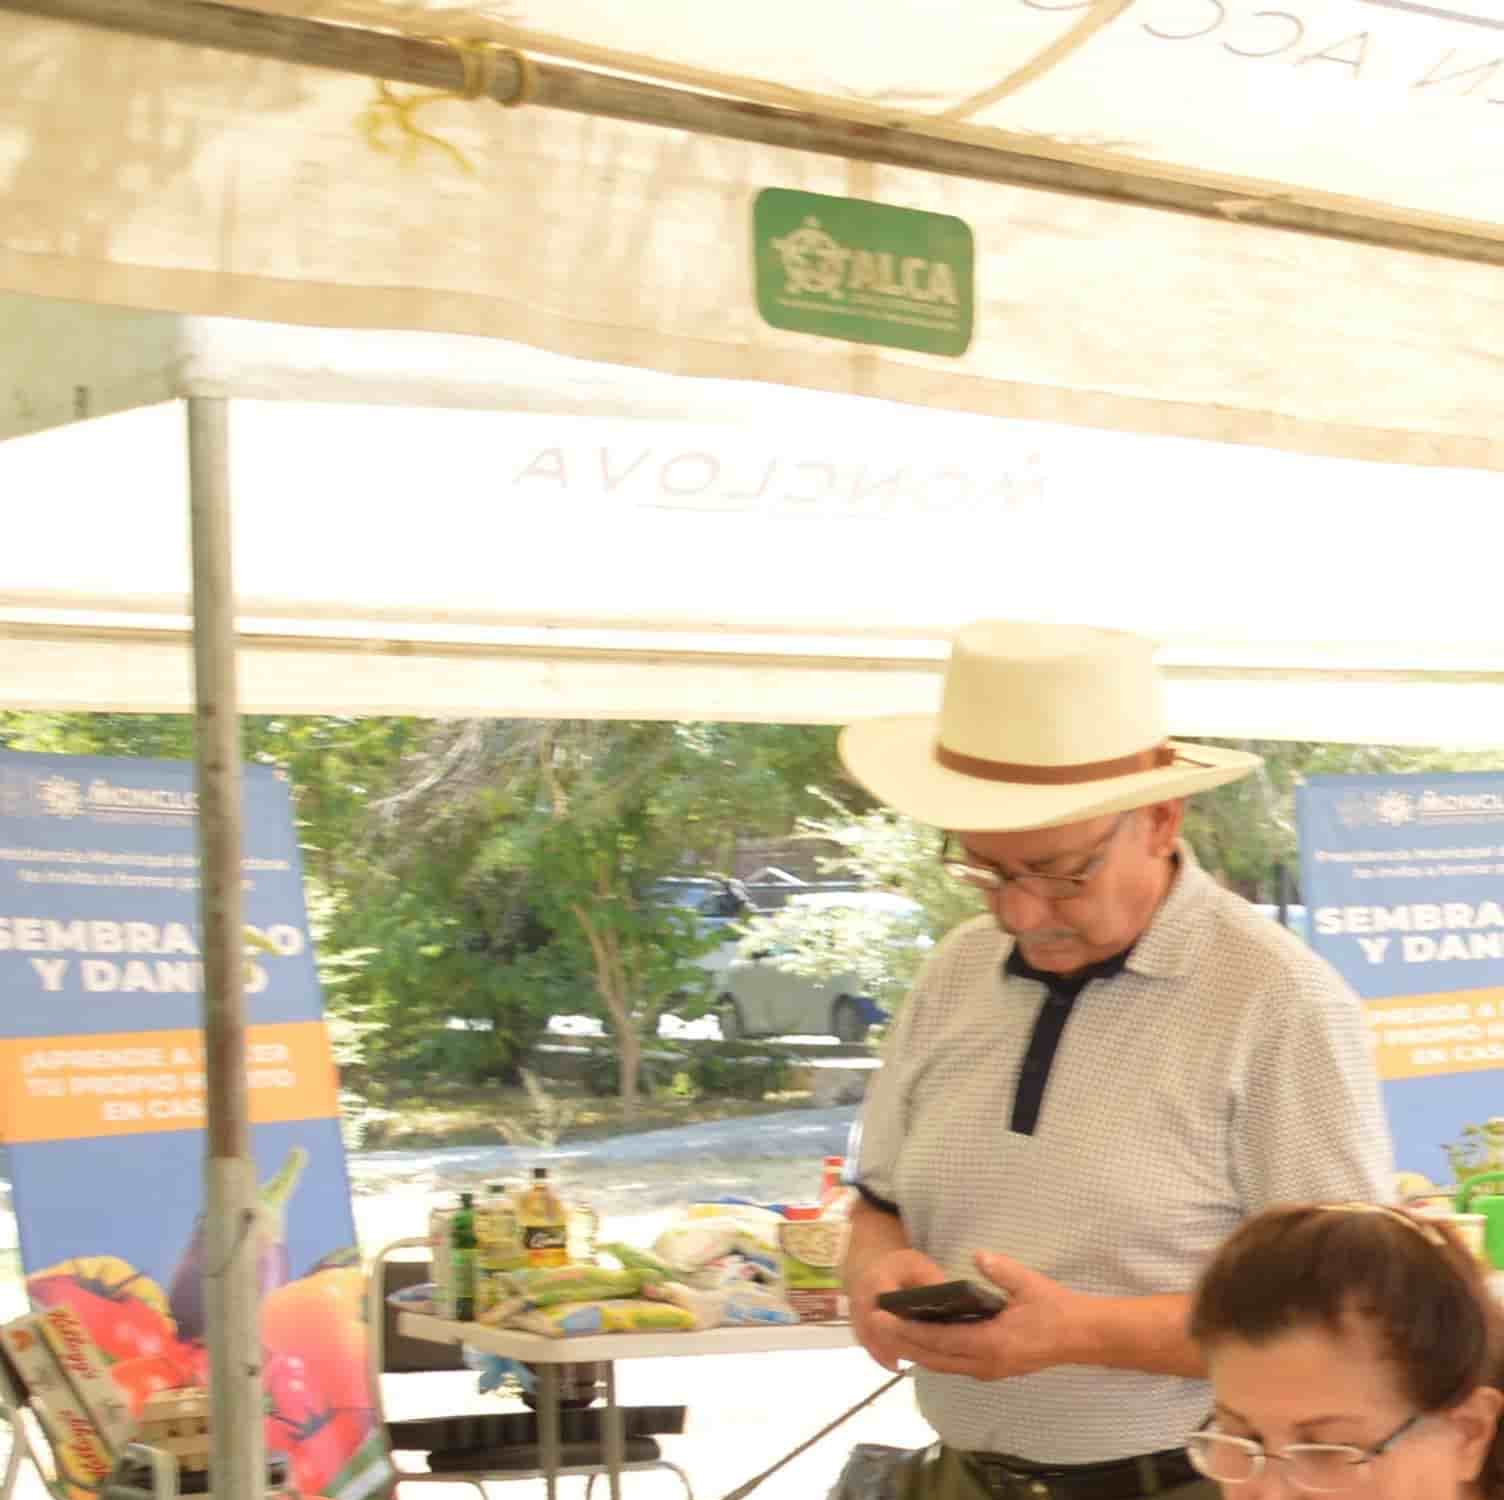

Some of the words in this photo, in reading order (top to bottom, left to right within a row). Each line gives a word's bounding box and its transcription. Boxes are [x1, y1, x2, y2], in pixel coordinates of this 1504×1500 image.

[1356, 937, 1391, 964] Y
[29, 957, 69, 992] Y
[79, 958, 269, 993] DANO
